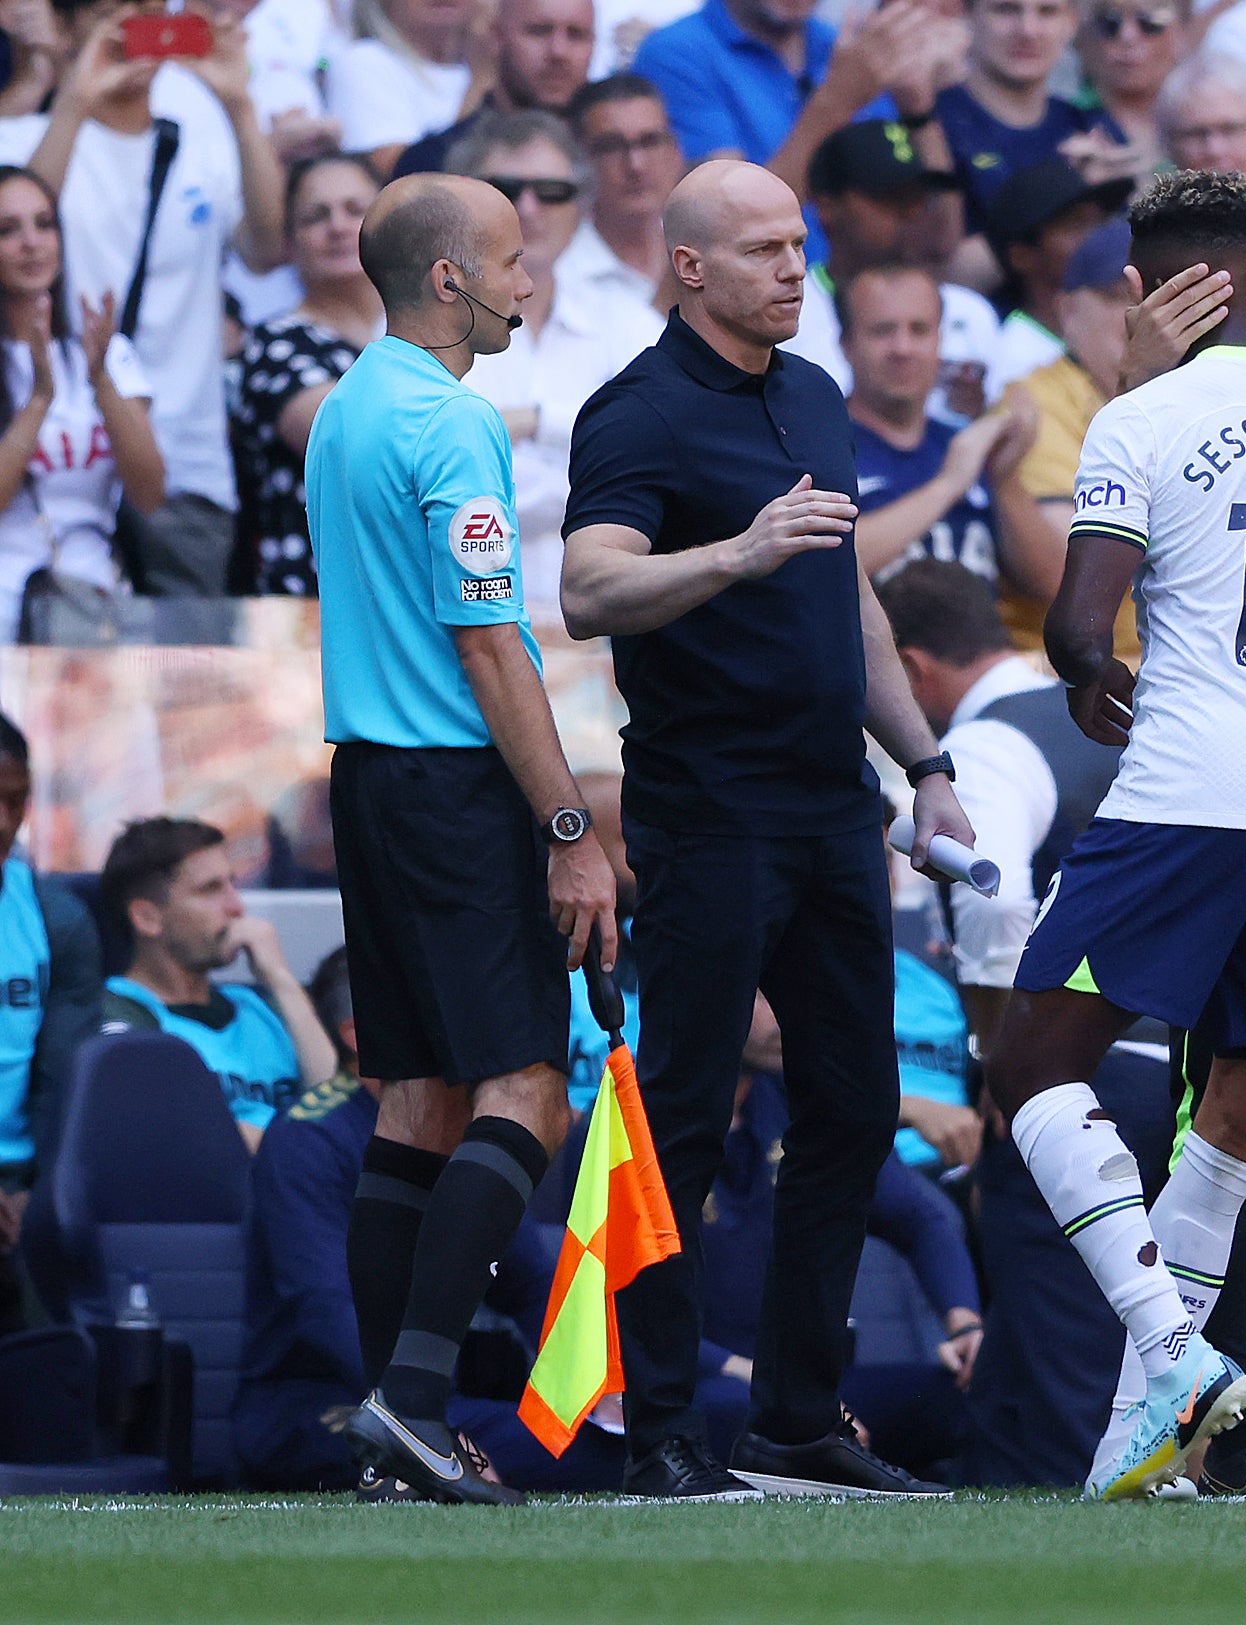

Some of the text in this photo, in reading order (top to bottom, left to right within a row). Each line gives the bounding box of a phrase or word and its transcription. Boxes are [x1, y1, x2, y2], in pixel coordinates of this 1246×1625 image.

[462, 514, 504, 540] EA
[461, 541, 504, 553] SPORTS
[461, 579, 508, 591] No room
[481, 588, 513, 600] racism
